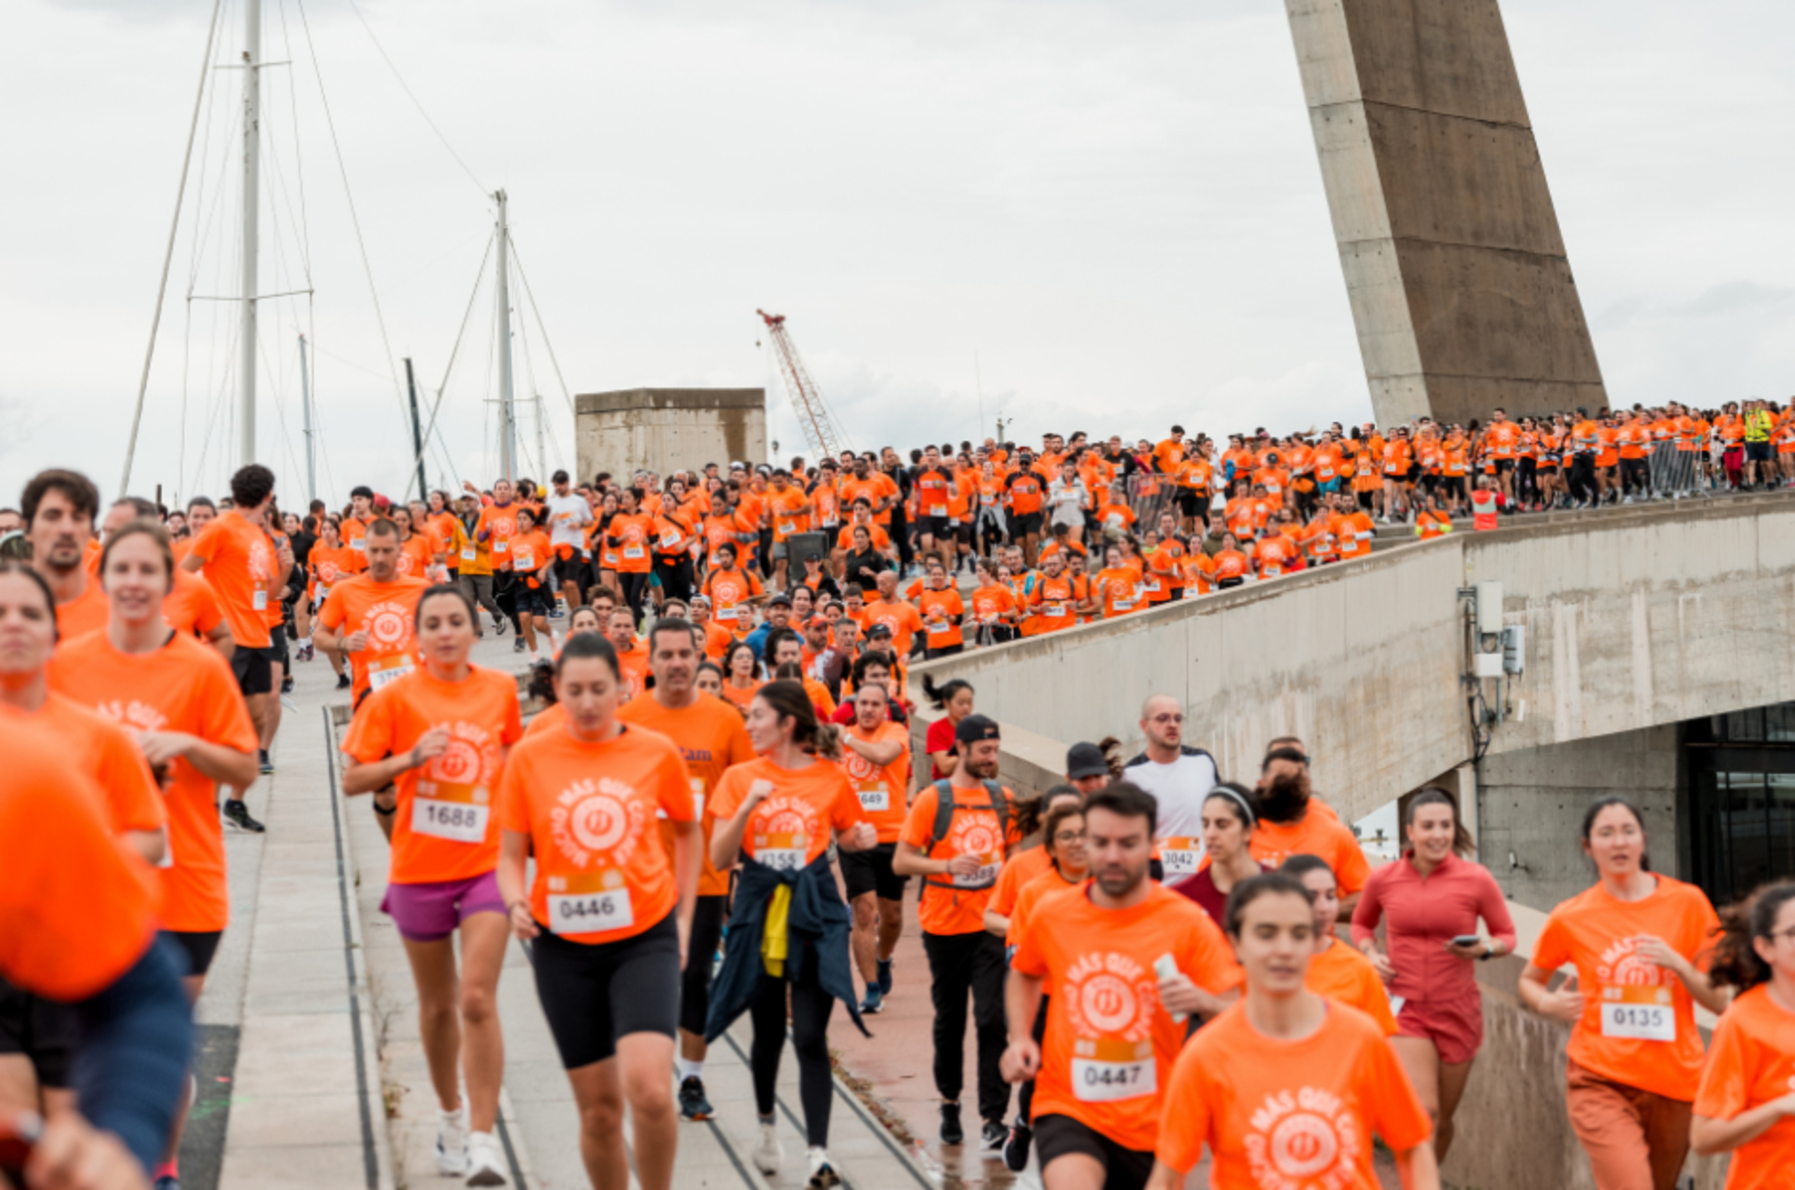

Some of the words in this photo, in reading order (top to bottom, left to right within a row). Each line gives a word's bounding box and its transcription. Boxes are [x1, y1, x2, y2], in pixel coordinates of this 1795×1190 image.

[860, 793, 882, 805] 649
[426, 805, 477, 828] 1688
[560, 897, 615, 919] 0446
[1613, 1008, 1663, 1027] 0135
[1084, 1065, 1141, 1086] 0447
